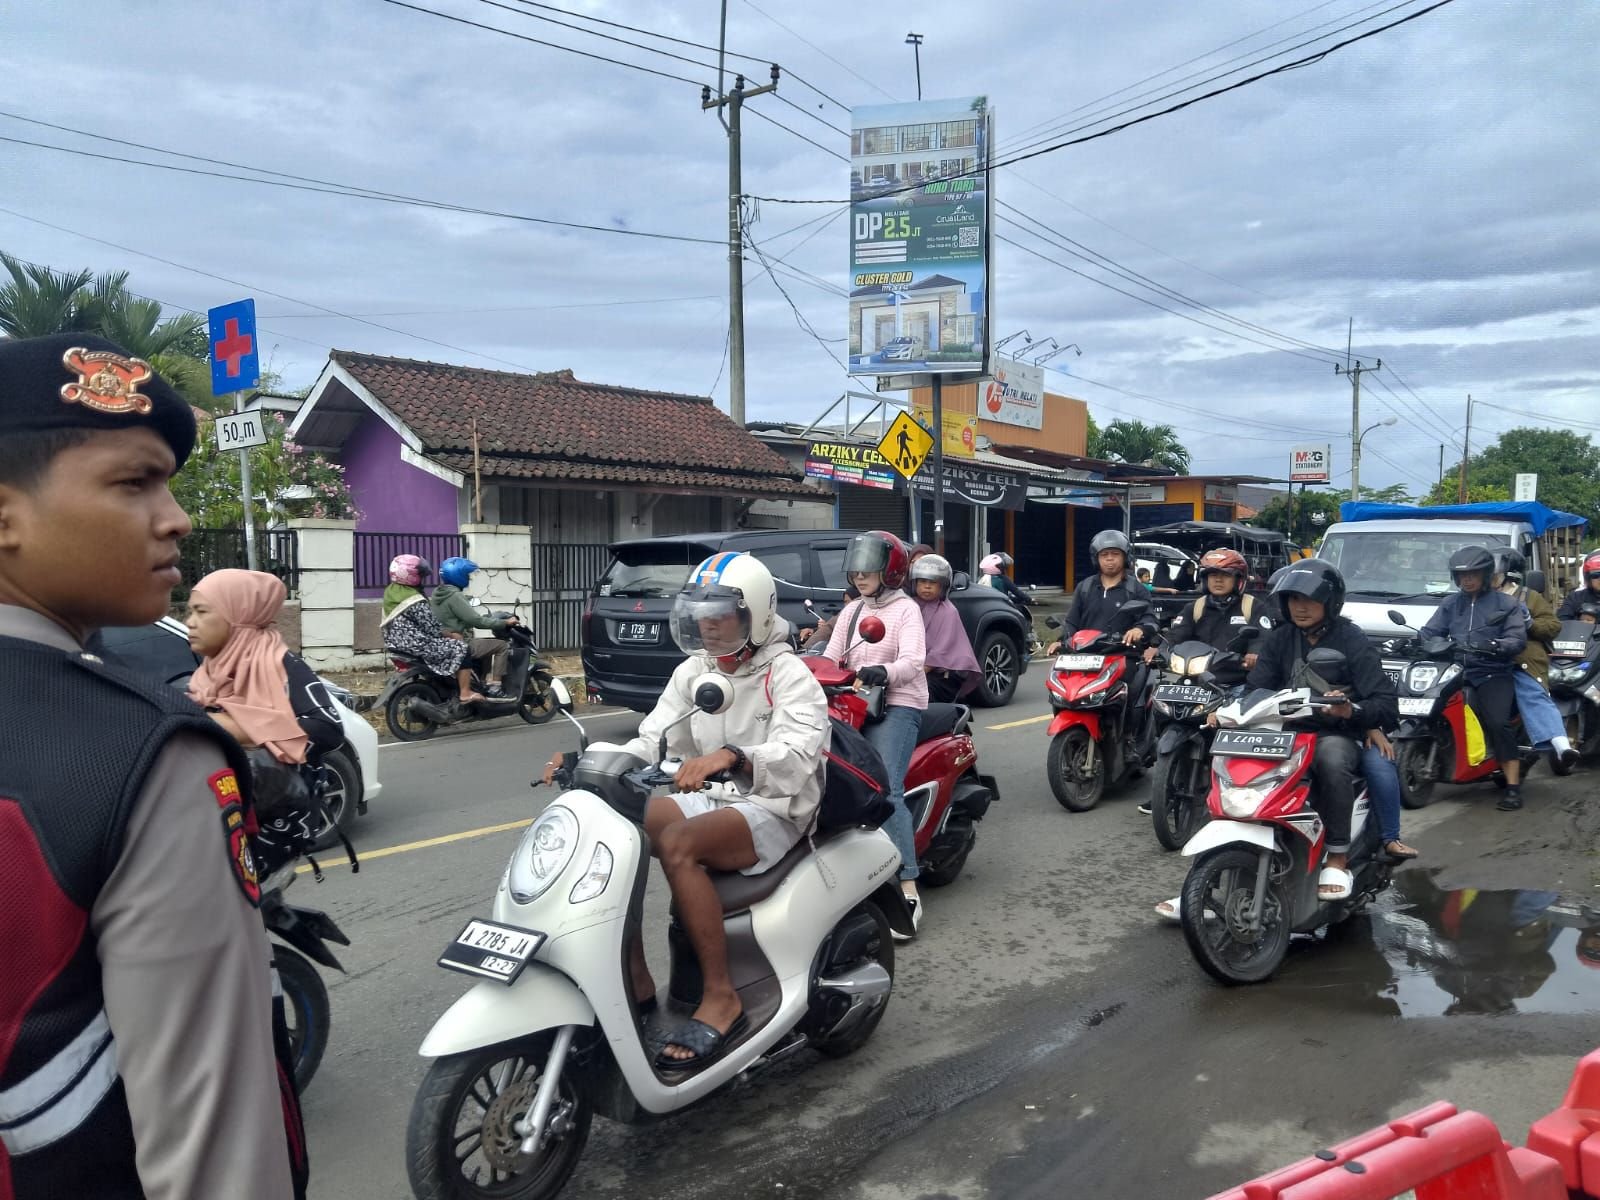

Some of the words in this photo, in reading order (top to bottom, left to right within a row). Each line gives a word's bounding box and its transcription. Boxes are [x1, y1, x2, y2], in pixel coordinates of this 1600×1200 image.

[856, 213, 882, 240] DP
[885, 216, 910, 238] 2.5
[913, 227, 920, 237] JT
[856, 273, 889, 285] CLUSTER
[891, 272, 912, 283] GOLD
[223, 422, 238, 442] 50
[243, 421, 255, 438] m
[810, 443, 860, 460] ARZIKY
[831, 458, 870, 469] ACCESSORIES
[986, 473, 1021, 487] CELL
[620, 623, 626, 634] F
[631, 623, 646, 634] 1739
[1222, 734, 1229, 743] A
[462, 928, 475, 943] A
[475, 930, 510, 951] 2785
[510, 938, 529, 956] JA
